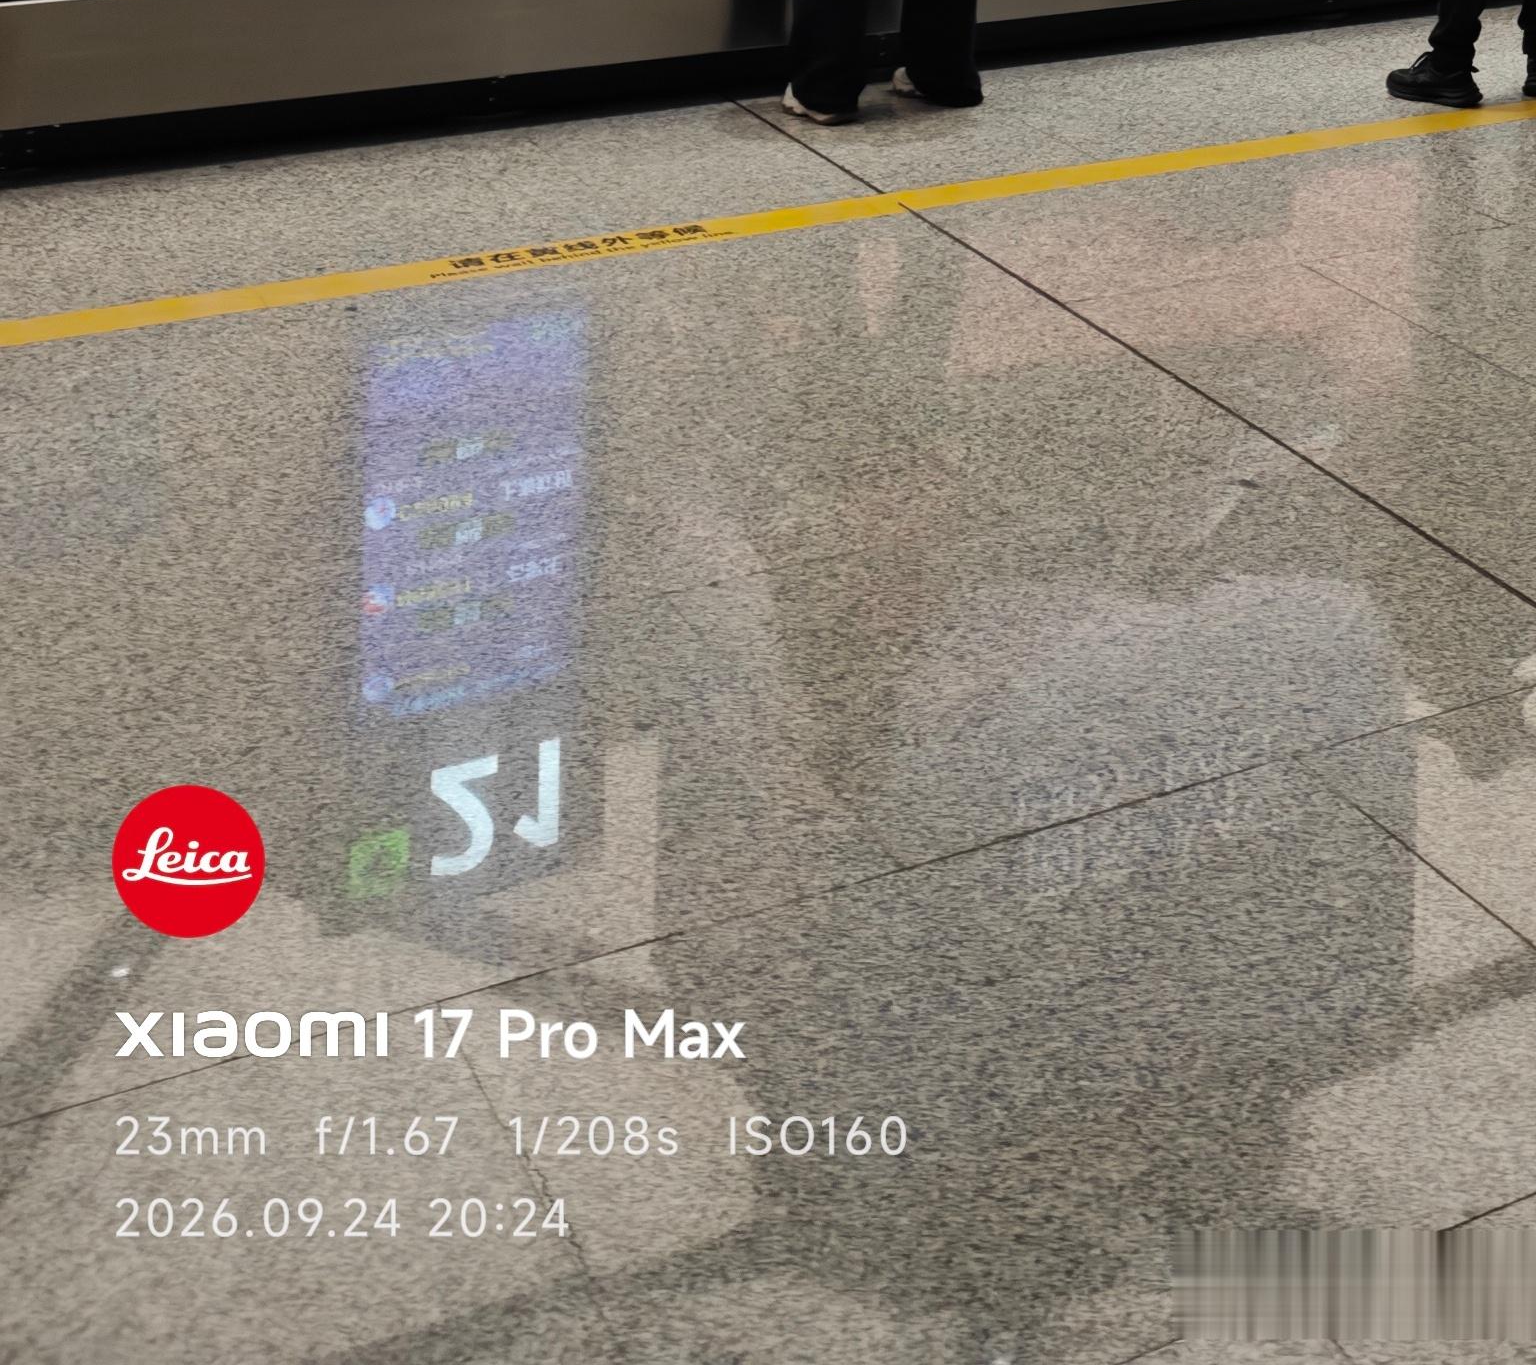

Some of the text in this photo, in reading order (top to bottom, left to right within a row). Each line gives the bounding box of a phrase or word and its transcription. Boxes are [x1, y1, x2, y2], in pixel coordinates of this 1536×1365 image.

[448, 224, 707, 270] 请在黄线外等候
[494, 259, 533, 270] wait
[539, 250, 601, 264] behind
[606, 245, 635, 255] the
[639, 235, 698, 250] yellow
